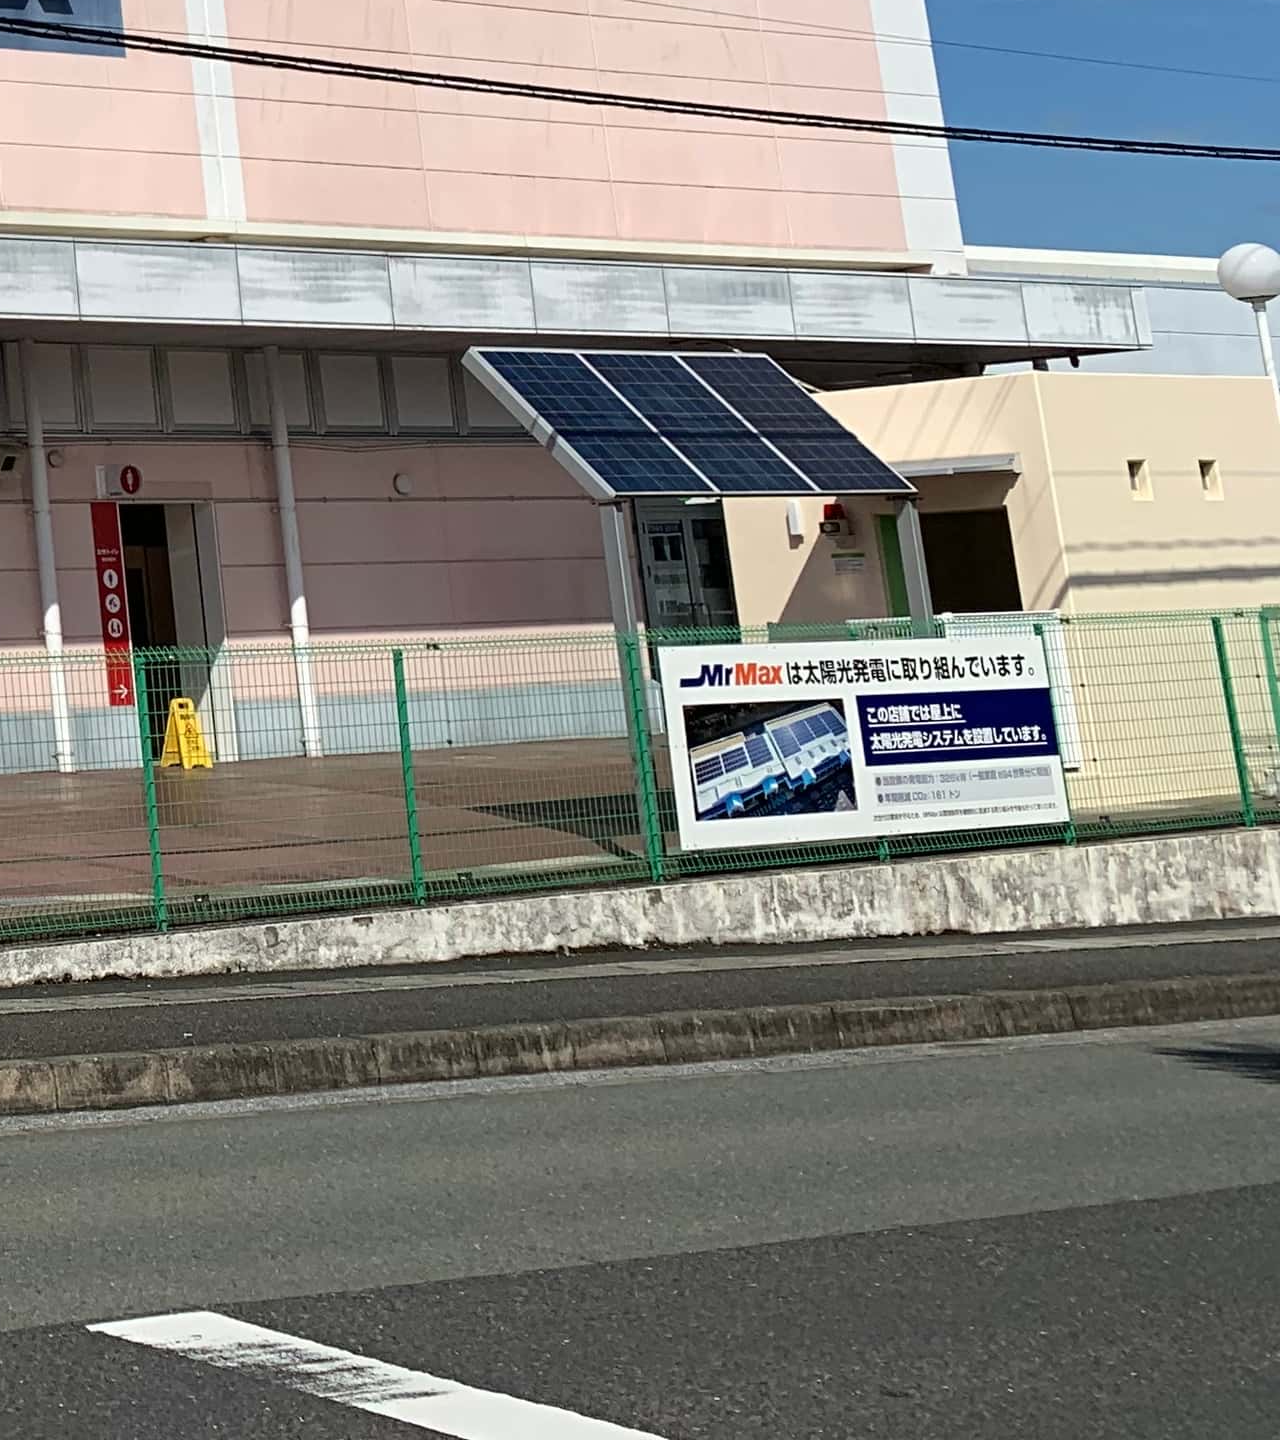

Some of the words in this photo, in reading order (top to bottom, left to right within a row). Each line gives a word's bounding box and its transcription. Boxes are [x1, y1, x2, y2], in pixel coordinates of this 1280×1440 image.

[680, 662, 783, 688] MrMax
[786, 653, 1035, 685] は太陽光発電に取り組んでいます。
[866, 702, 962, 723] この店舗では屋上に
[870, 725, 1047, 750] 太陽光発電システムを設置しています。
